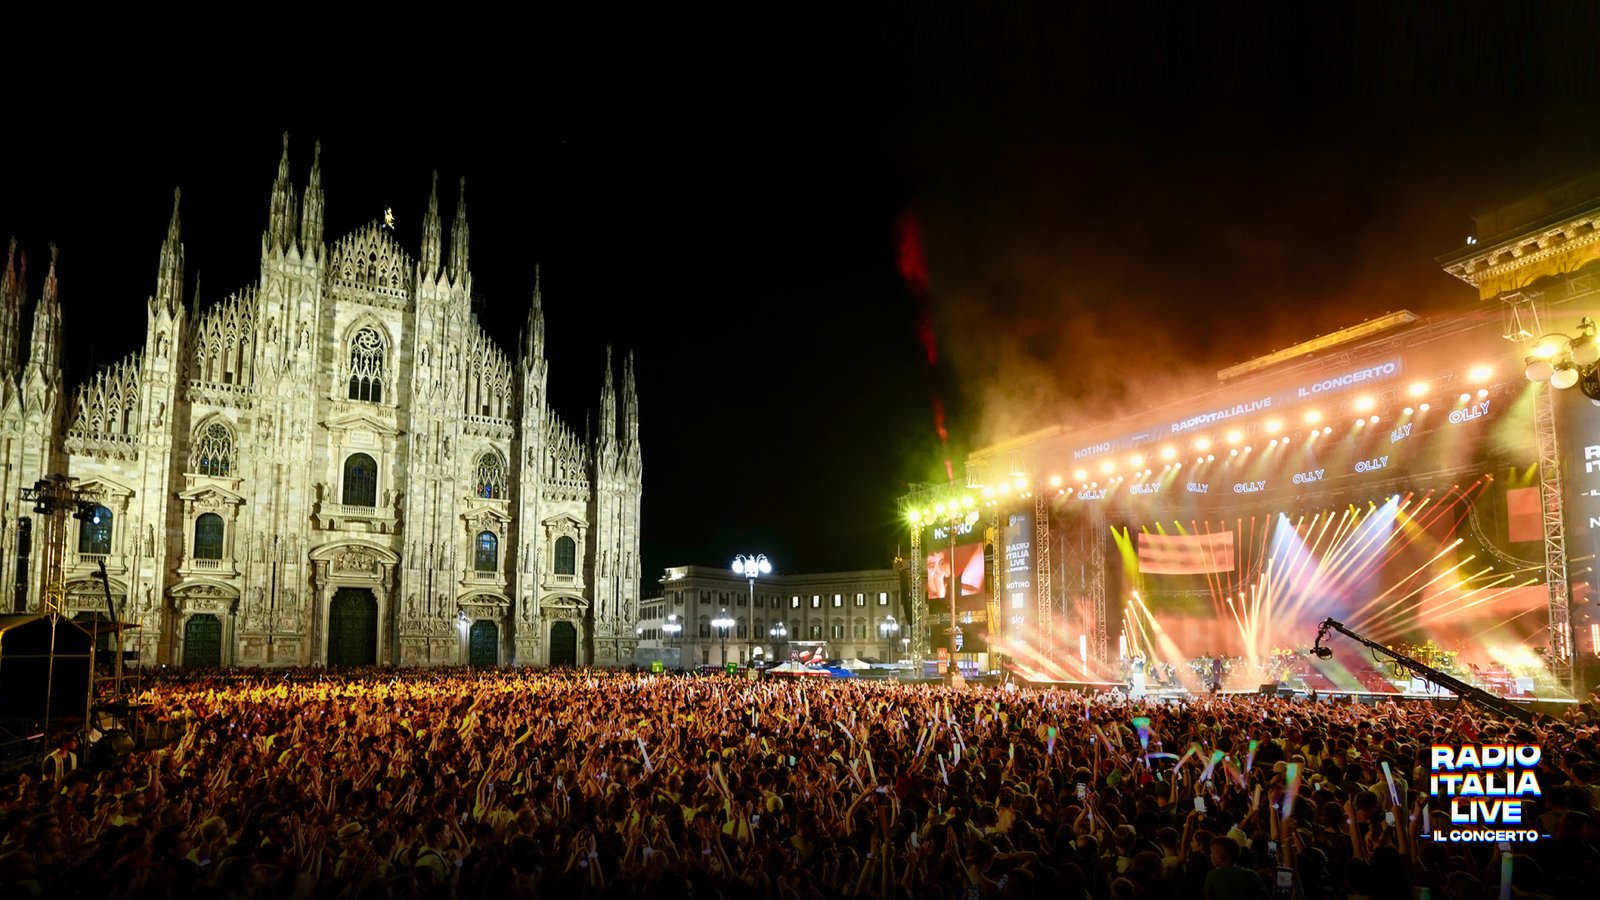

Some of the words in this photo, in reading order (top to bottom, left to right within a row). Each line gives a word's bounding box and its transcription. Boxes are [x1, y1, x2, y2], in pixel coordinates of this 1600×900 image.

[1298, 387, 1310, 397] IL
[1312, 362, 1395, 393] CONCERTO
[1448, 399, 1490, 424] OLLY
[1073, 442, 1110, 460] NOTINO
[1355, 455, 1389, 473] OLLY
[1292, 468, 1325, 484] OLLY
[1129, 482, 1161, 495] OLLY
[1187, 480, 1209, 494] OLLY
[1233, 480, 1267, 493] OLLY
[1078, 488, 1108, 501] OLLY
[934, 523, 973, 540] NOINO
[1005, 542, 1030, 553] RADIO
[1005, 549, 1030, 561] ITALIA
[1010, 558, 1025, 567] LIVE
[1006, 580, 1030, 590] NOTINO
[1011, 615, 1025, 625] sky
